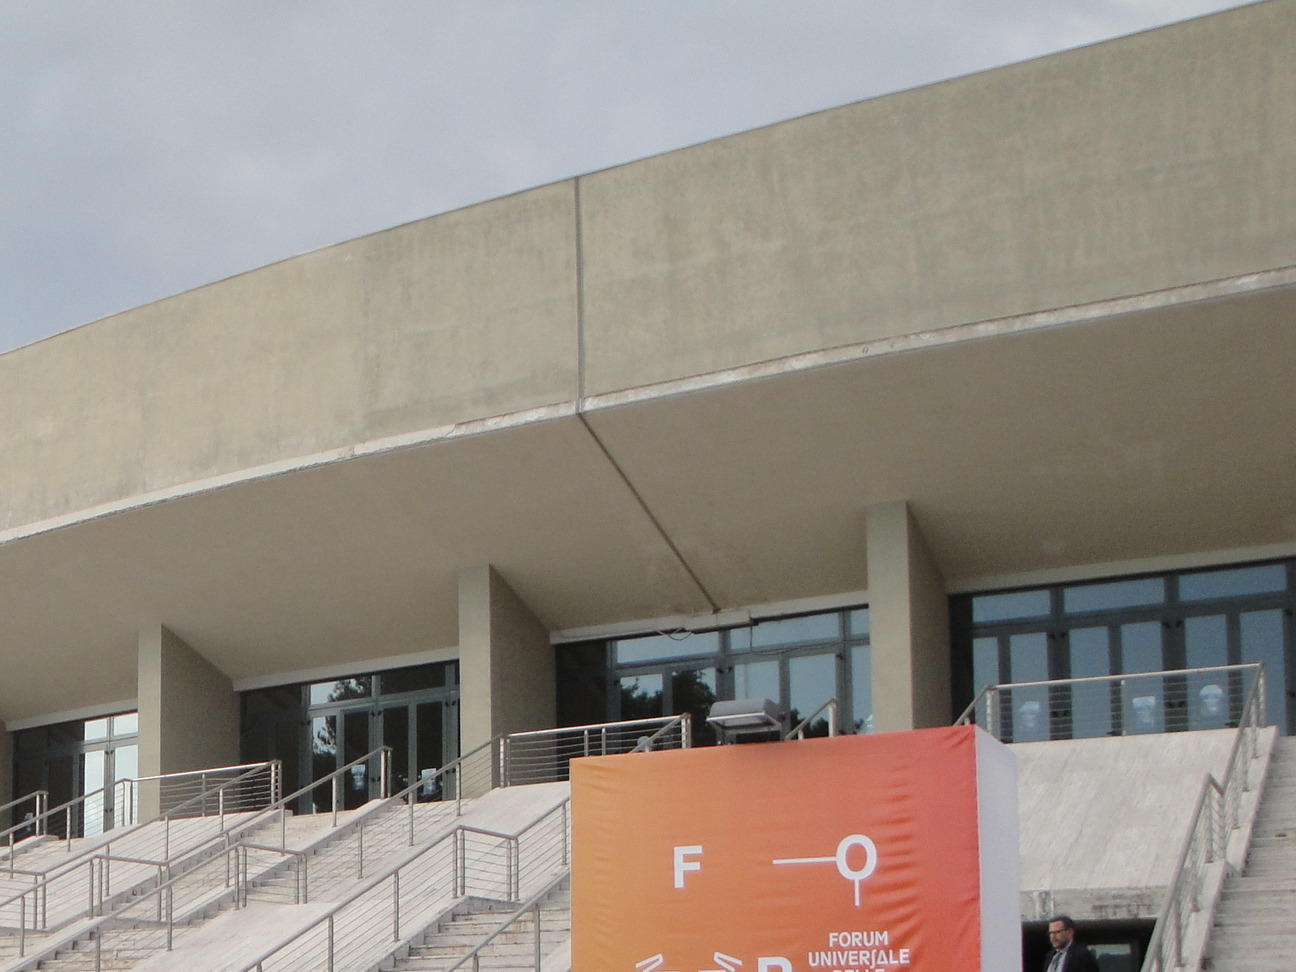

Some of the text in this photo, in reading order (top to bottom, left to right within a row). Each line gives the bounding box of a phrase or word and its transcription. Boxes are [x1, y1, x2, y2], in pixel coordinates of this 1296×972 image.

[673, 833, 878, 890] F O
[829, 931, 889, 948] FORUM
